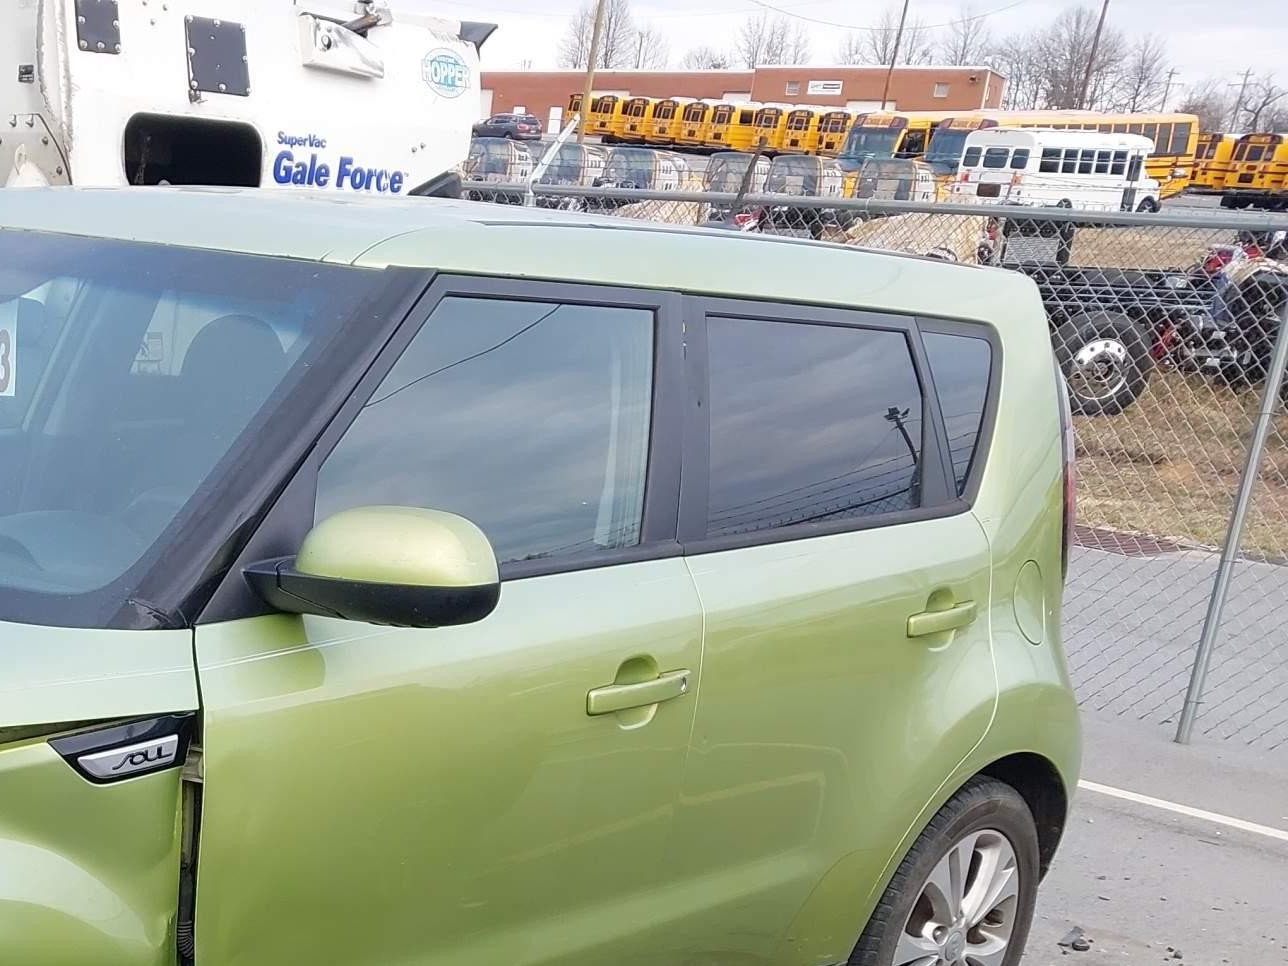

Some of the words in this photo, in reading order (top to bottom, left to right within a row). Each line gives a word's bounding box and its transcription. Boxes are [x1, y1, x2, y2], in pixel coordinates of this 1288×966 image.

[421, 59, 472, 88] HOPPER
[277, 130, 328, 150] SuperVac
[273, 150, 331, 187] Gale
[336, 156, 404, 194] Force
